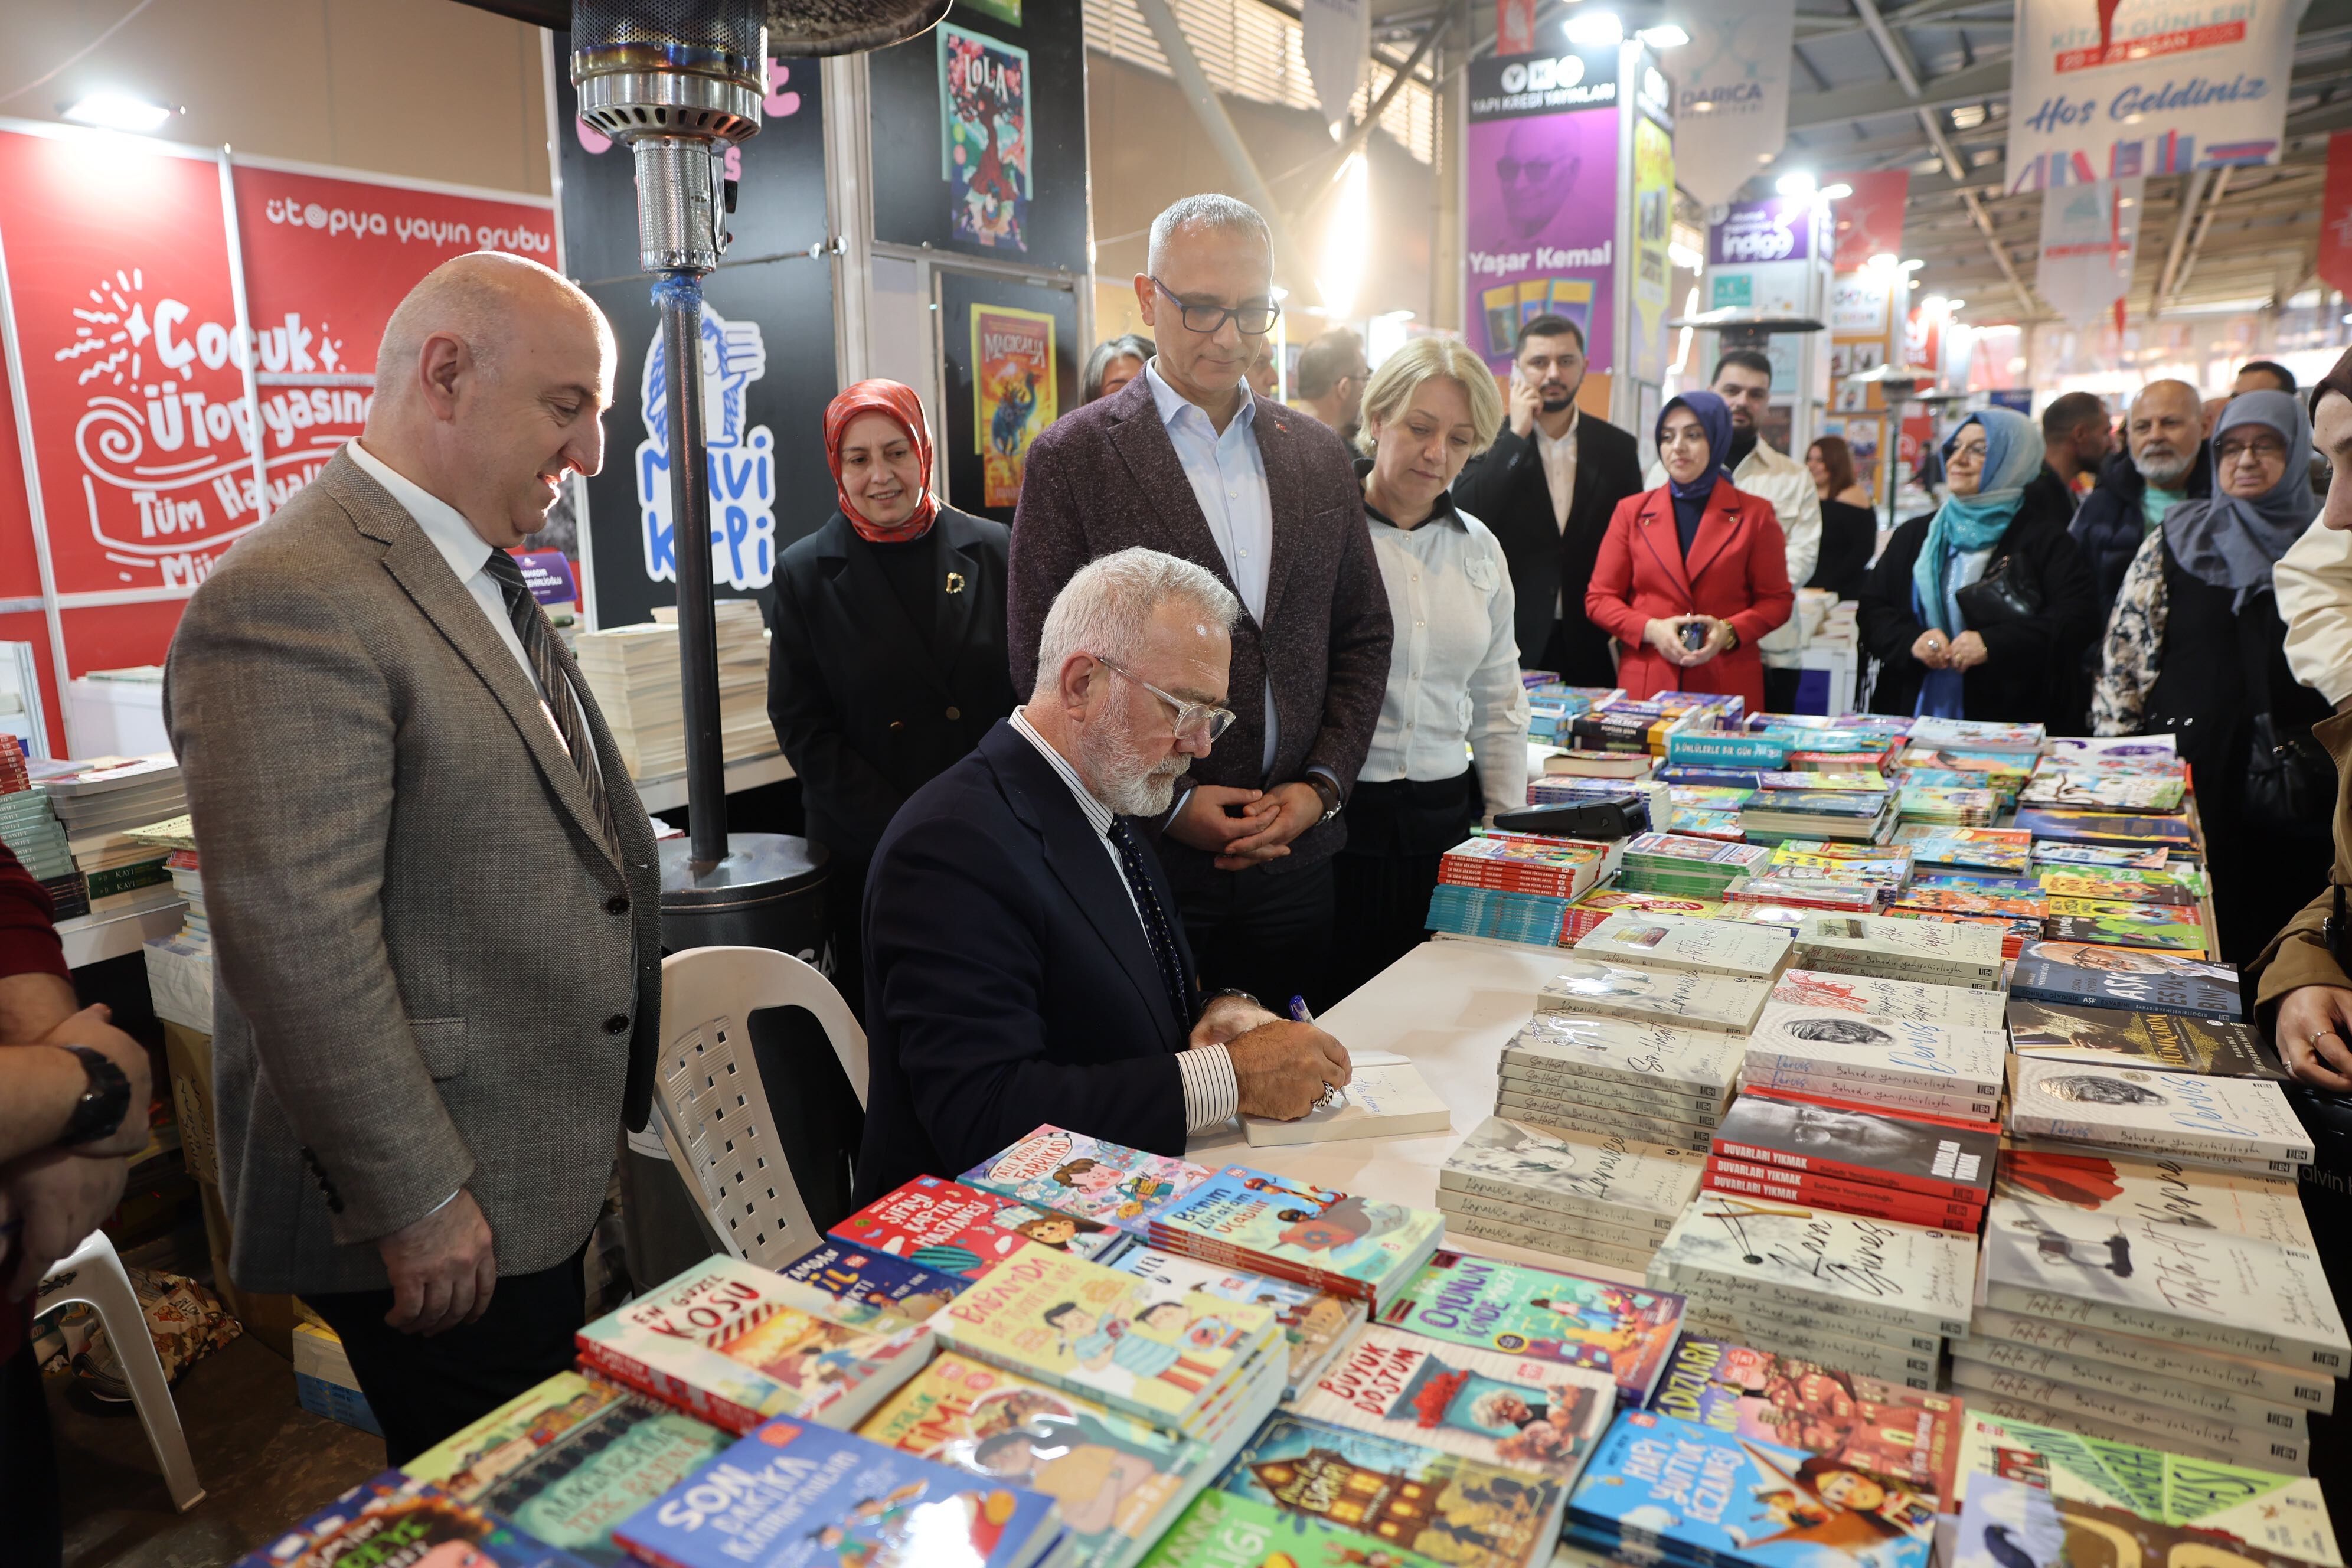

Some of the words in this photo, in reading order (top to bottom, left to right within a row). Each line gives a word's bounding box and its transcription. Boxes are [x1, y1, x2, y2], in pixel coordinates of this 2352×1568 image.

[964, 53, 1009, 104] LOLA
[1472, 97, 1501, 115] YAPI
[1502, 90, 1544, 111] KREDİ
[1544, 83, 1616, 107] YAYINLARI
[2026, 96, 2096, 133] Hoş
[2109, 74, 2268, 120] Geldiniz
[394, 216, 471, 247] yayın
[476, 225, 550, 253] grubu
[1469, 250, 1530, 277] Yaşar
[1535, 240, 1612, 269] Kemal
[153, 298, 316, 381] Çocuk
[132, 491, 205, 538] Tüm
[1683, 743, 1720, 754] ÜNLÜLERLE
[1723, 745, 1734, 755] BİR
[1738, 746, 1752, 755] GÜN
[116, 868, 134, 878] KAYI
[117, 880, 135, 891] KAYI
[2021, 989, 2044, 998] SONRA
[2049, 992, 2079, 1002] GİYDİRİR
[2101, 999, 2131, 1008] ESVABINI
[2159, 1007, 2209, 1018] YENİŞEHİRLİOĞLU
[2103, 972, 2153, 1001] AŞK
[992, 1162, 1020, 1179] TATLI
[1008, 1138, 1048, 1162] RÜYALAR
[1014, 1140, 1070, 1180] FABRİKASI
[1717, 1159, 1765, 1180] DUVARLARI
[1766, 1169, 1801, 1187] YIKMAK
[1723, 1143, 1770, 1162] DUVARLARI
[1772, 1153, 1808, 1169] YIKMAK
[1714, 1175, 1761, 1194] DUVARLARI
[1763, 1184, 1798, 1201] YIKMAK
[878, 1193, 936, 1226] ŞİFAYI
[903, 1199, 965, 1233] KAPTIK
[910, 1200, 992, 1248] HASTANESİ
[948, 1256, 1056, 1325] BABAMDA
[1419, 1262, 1495, 1330] OYUNUN
[1318, 1341, 1390, 1399] BÜYÜK
[1354, 1345, 1424, 1415] DOSTUM
[656, 1462, 757, 1533] SON
